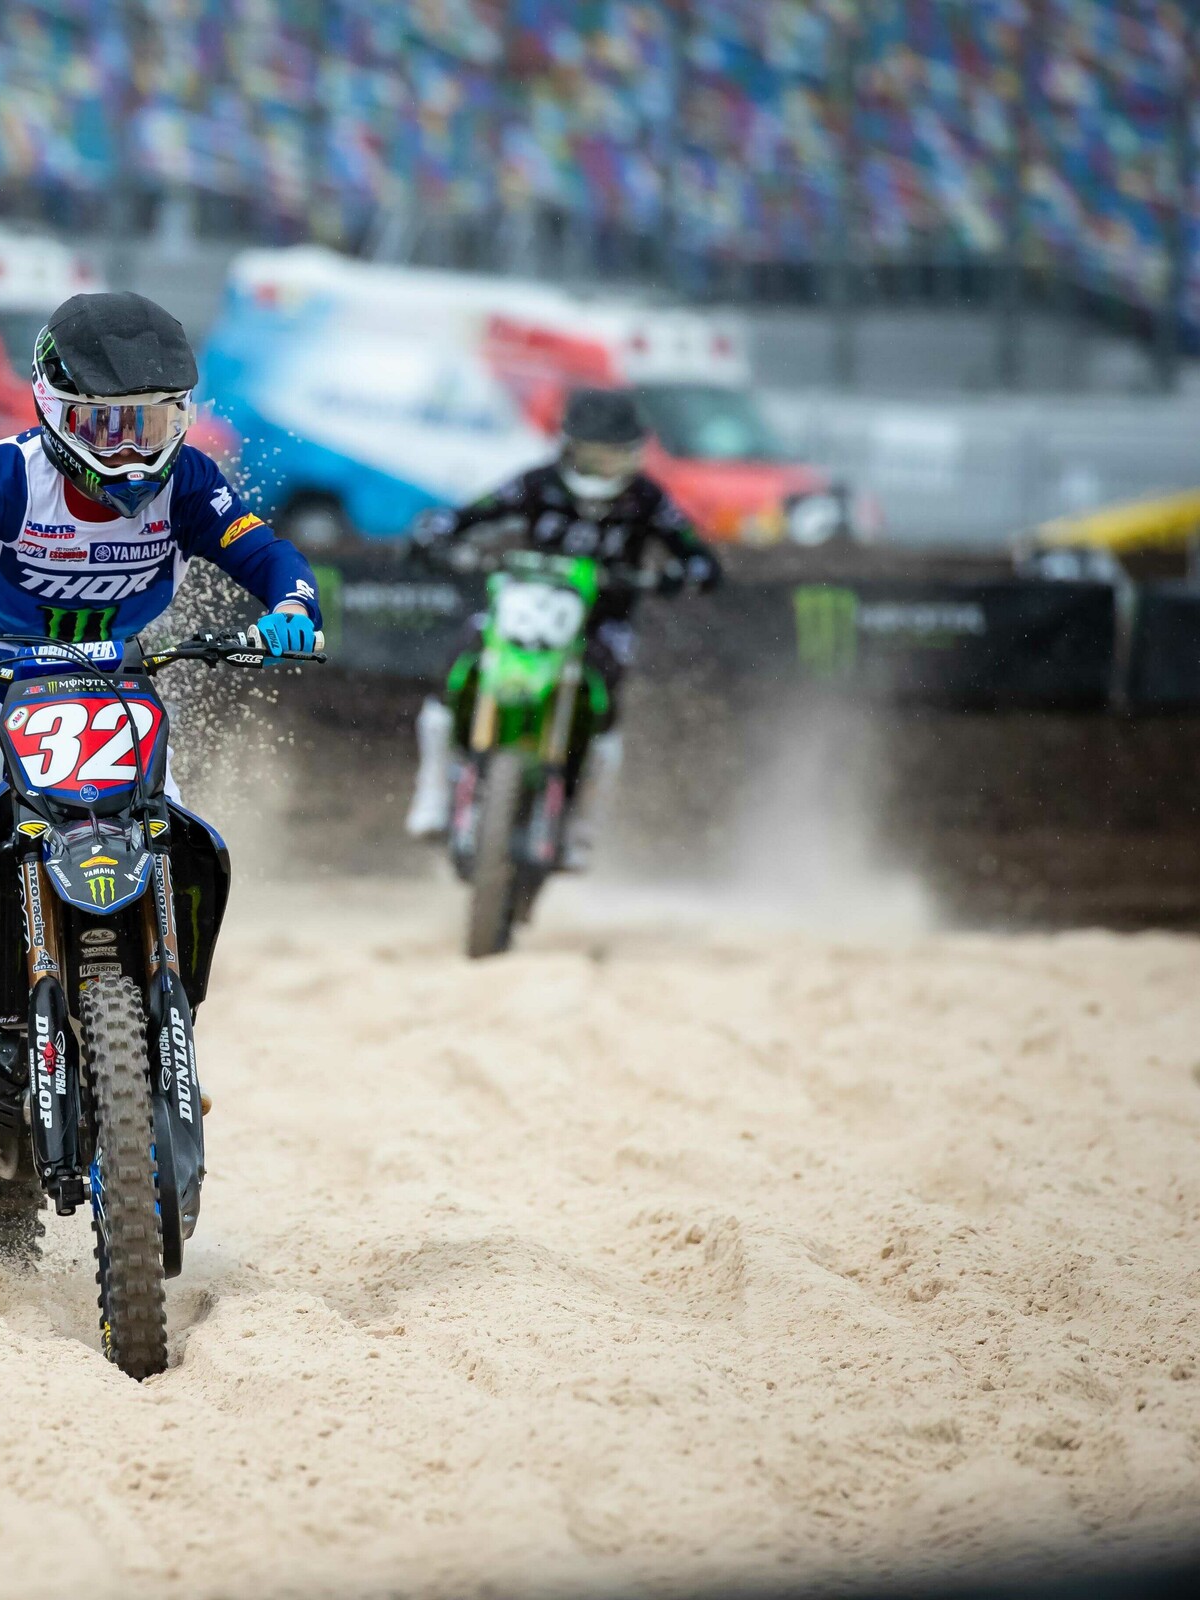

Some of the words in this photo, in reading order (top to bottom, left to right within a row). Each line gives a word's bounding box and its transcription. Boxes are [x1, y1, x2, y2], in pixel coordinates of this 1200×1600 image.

[26, 520, 76, 534] PARTS
[138, 520, 170, 535] AMA
[112, 540, 168, 561] YAMAHA
[19, 567, 160, 601] THOR
[266, 628, 280, 649] THOR
[227, 653, 264, 664] ARC
[59, 678, 116, 688] MONSTER
[20, 702, 154, 788] 32
[84, 867, 116, 878] YAMAHA
[155, 854, 169, 936] enzoracin
[8, 1014, 21, 1023] Air
[159, 1026, 172, 1067] CYCRA
[36, 1014, 53, 1129] DUNLOP
[56, 1054, 67, 1095] CYCRA
[170, 1007, 193, 1124] DUNLOP
